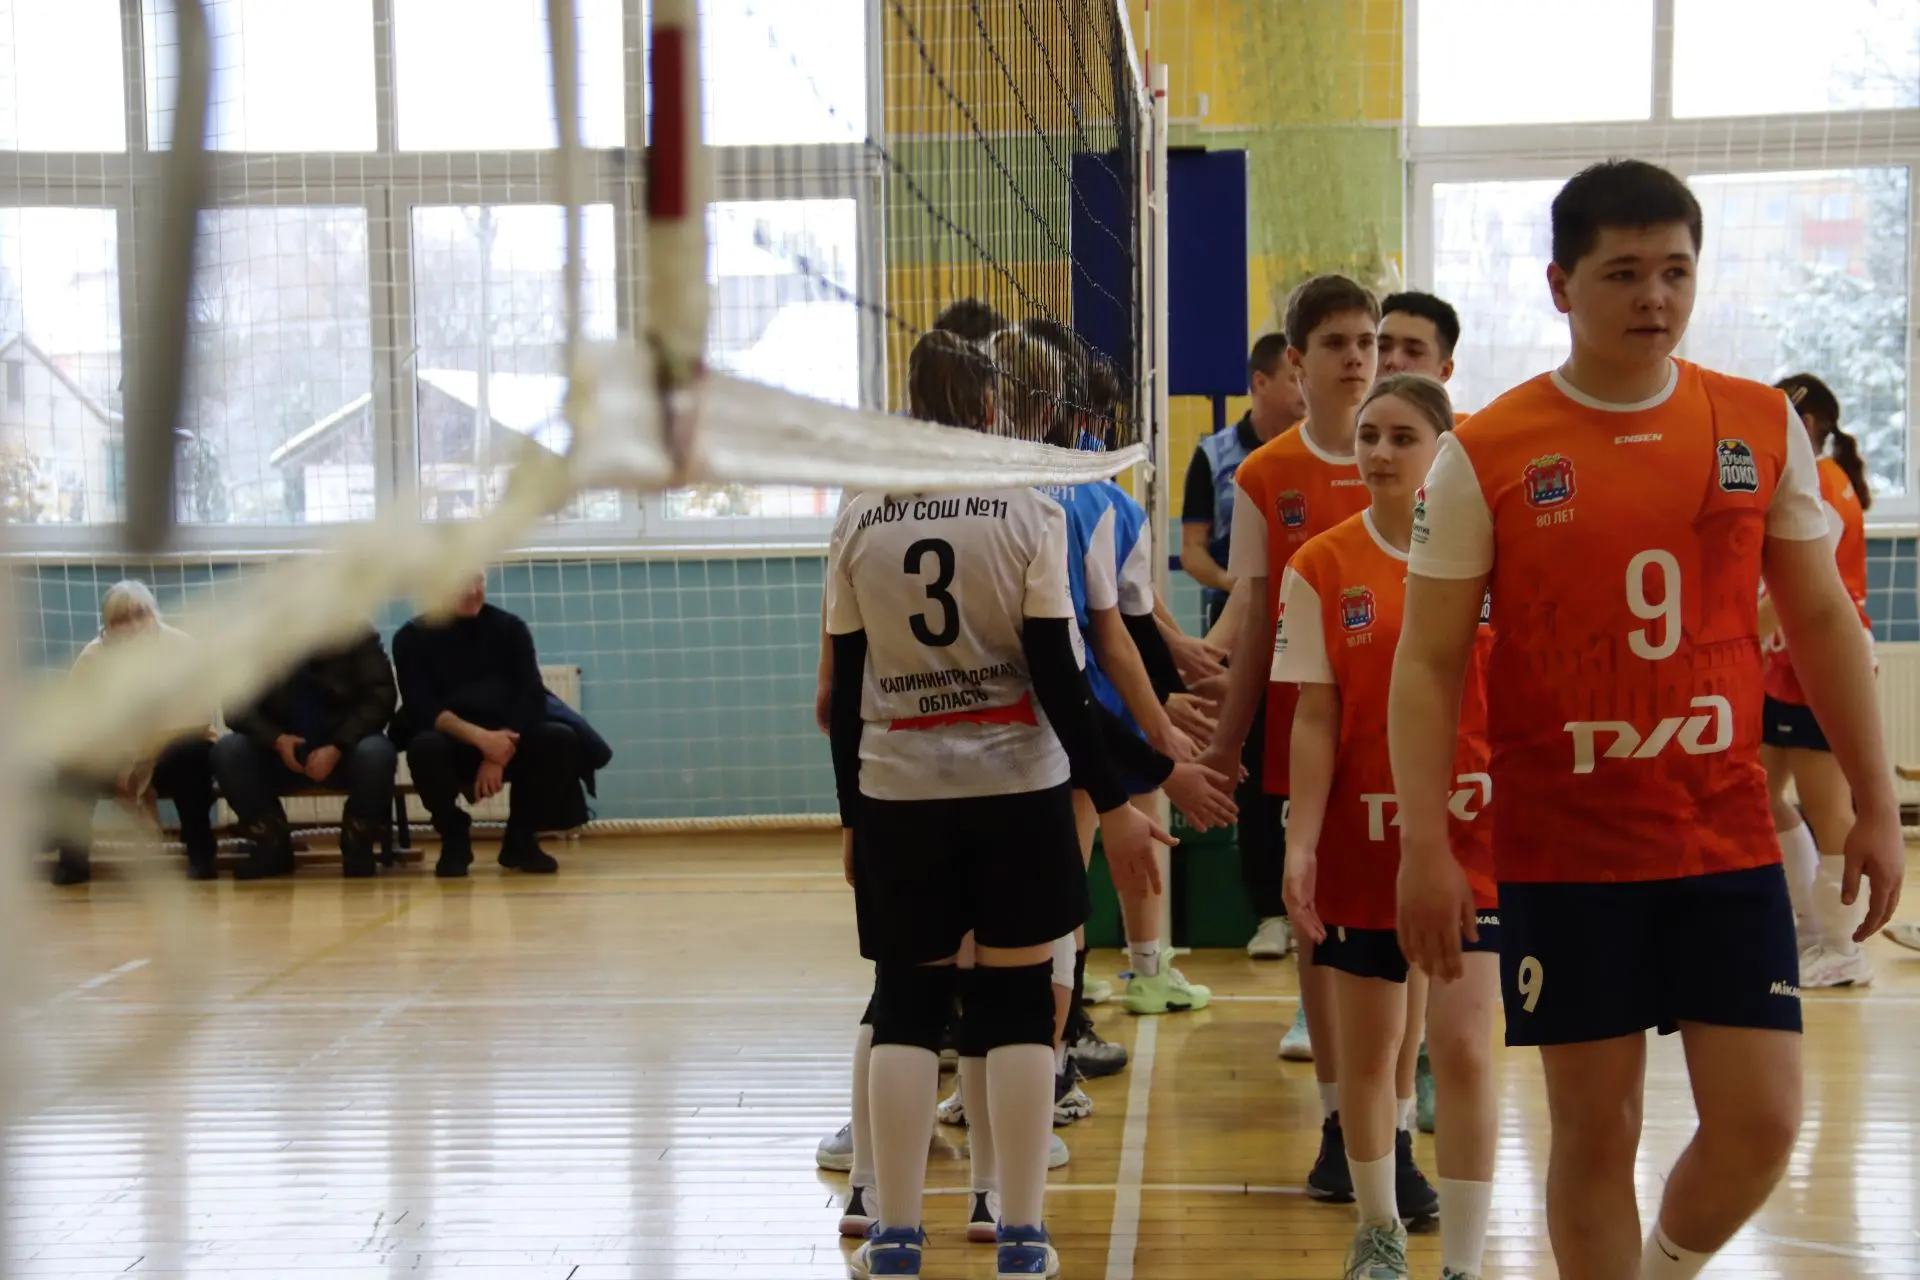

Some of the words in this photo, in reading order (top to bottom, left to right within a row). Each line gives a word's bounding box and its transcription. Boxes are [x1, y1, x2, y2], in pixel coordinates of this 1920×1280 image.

[1721, 465, 1756, 485] ЛОКО
[857, 502, 909, 530] МАОУ
[913, 498, 960, 521] СОШ
[965, 496, 1008, 519] №11
[1536, 512, 1551, 528] 80
[1554, 508, 1576, 525] ЛЕТ
[903, 538, 960, 647] 3
[1625, 549, 1681, 660] 9
[919, 689, 989, 714] ОБЛАСТЬ
[1518, 956, 1543, 1013] 9
